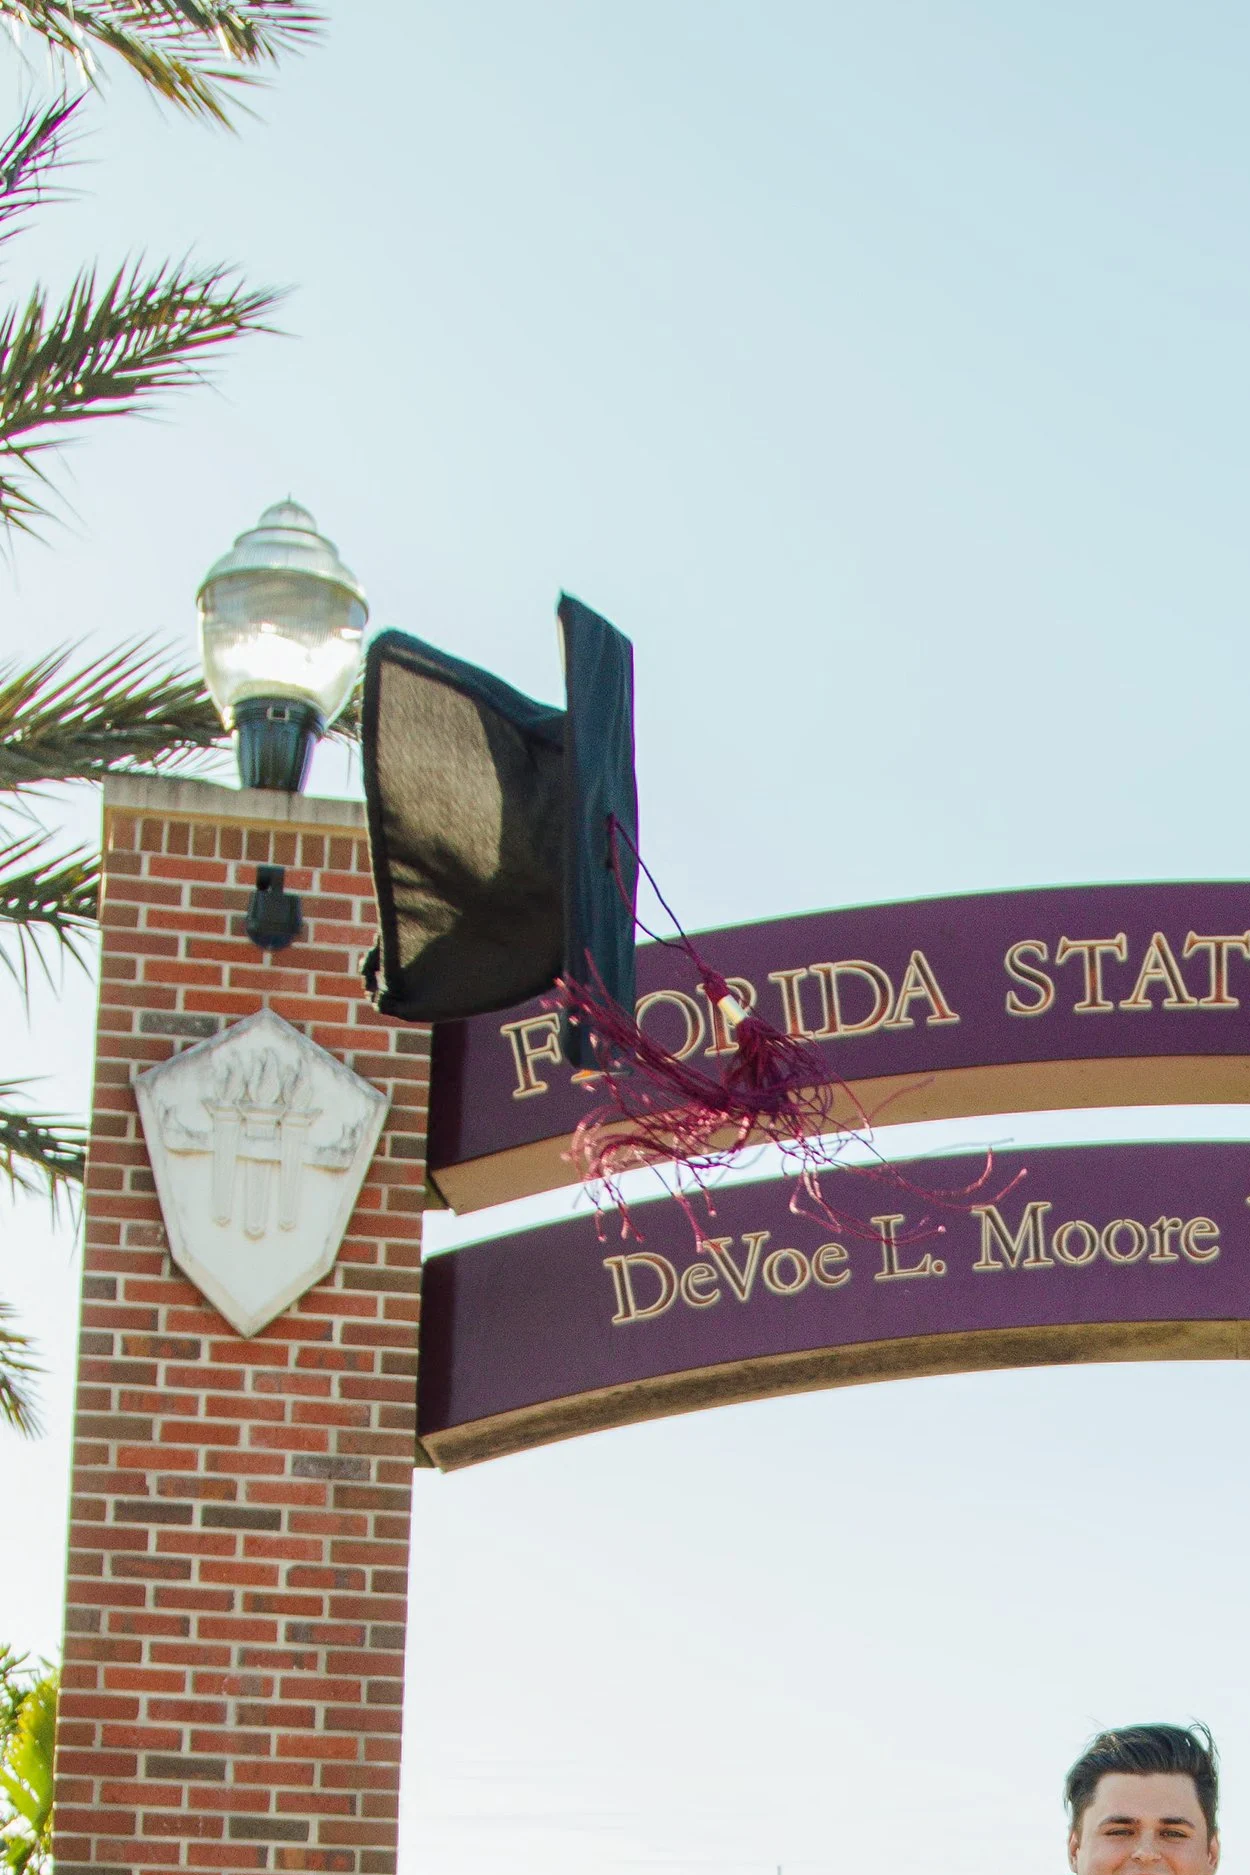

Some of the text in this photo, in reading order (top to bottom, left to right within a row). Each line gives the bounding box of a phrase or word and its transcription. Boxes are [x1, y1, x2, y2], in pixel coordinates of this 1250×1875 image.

[500, 948, 961, 1099] FORIDA
[602, 1230, 851, 1327] DeVoe
[870, 1213, 947, 1283] L.
[970, 1201, 1220, 1274] Moore
